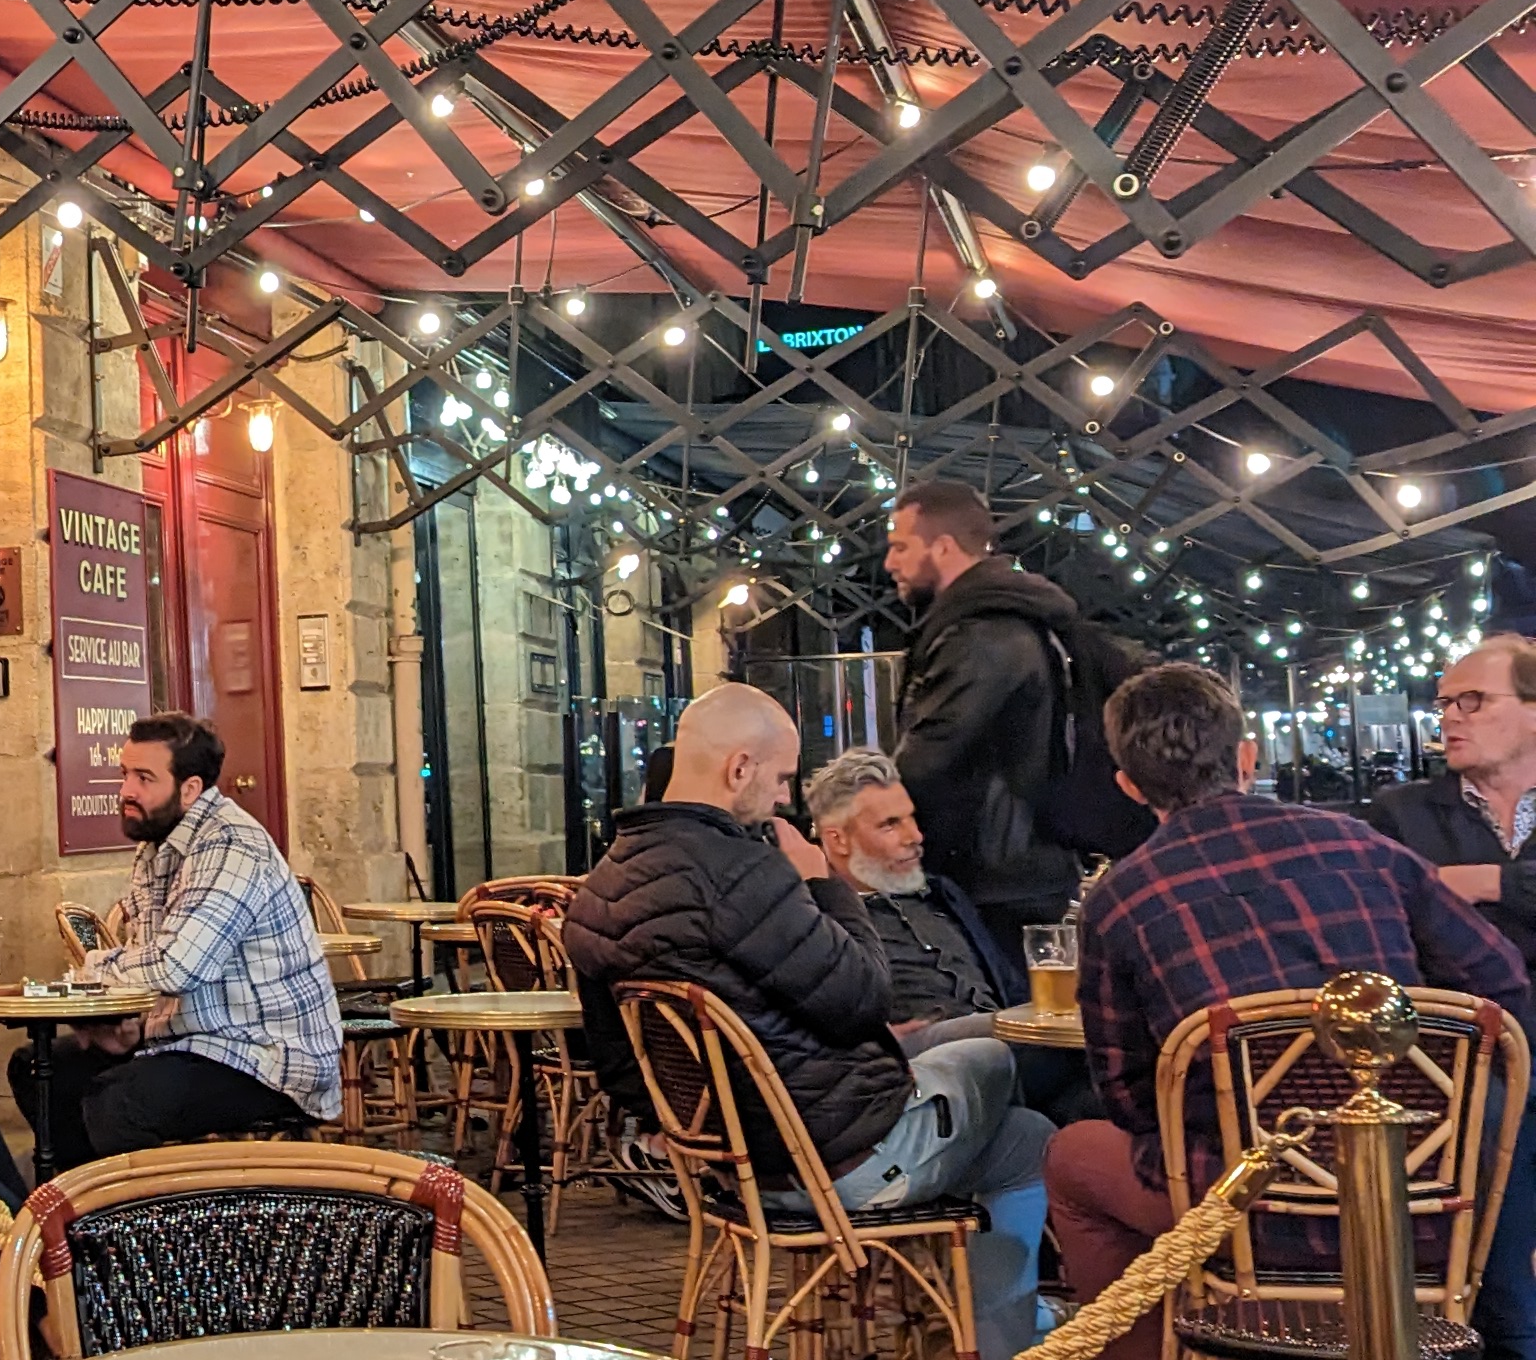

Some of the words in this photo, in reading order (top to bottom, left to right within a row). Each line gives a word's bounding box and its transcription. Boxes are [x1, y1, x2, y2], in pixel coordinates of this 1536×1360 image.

[59, 508, 140, 555] VINTAGE
[80, 560, 127, 598] CAFE
[68, 634, 107, 665] SERVICE
[108, 640, 121, 666] AU
[122, 640, 140, 668] BAR
[77, 707, 109, 735] HAPPY
[71, 795, 108, 816] PRODUITS
[109, 794, 120, 815] DE
